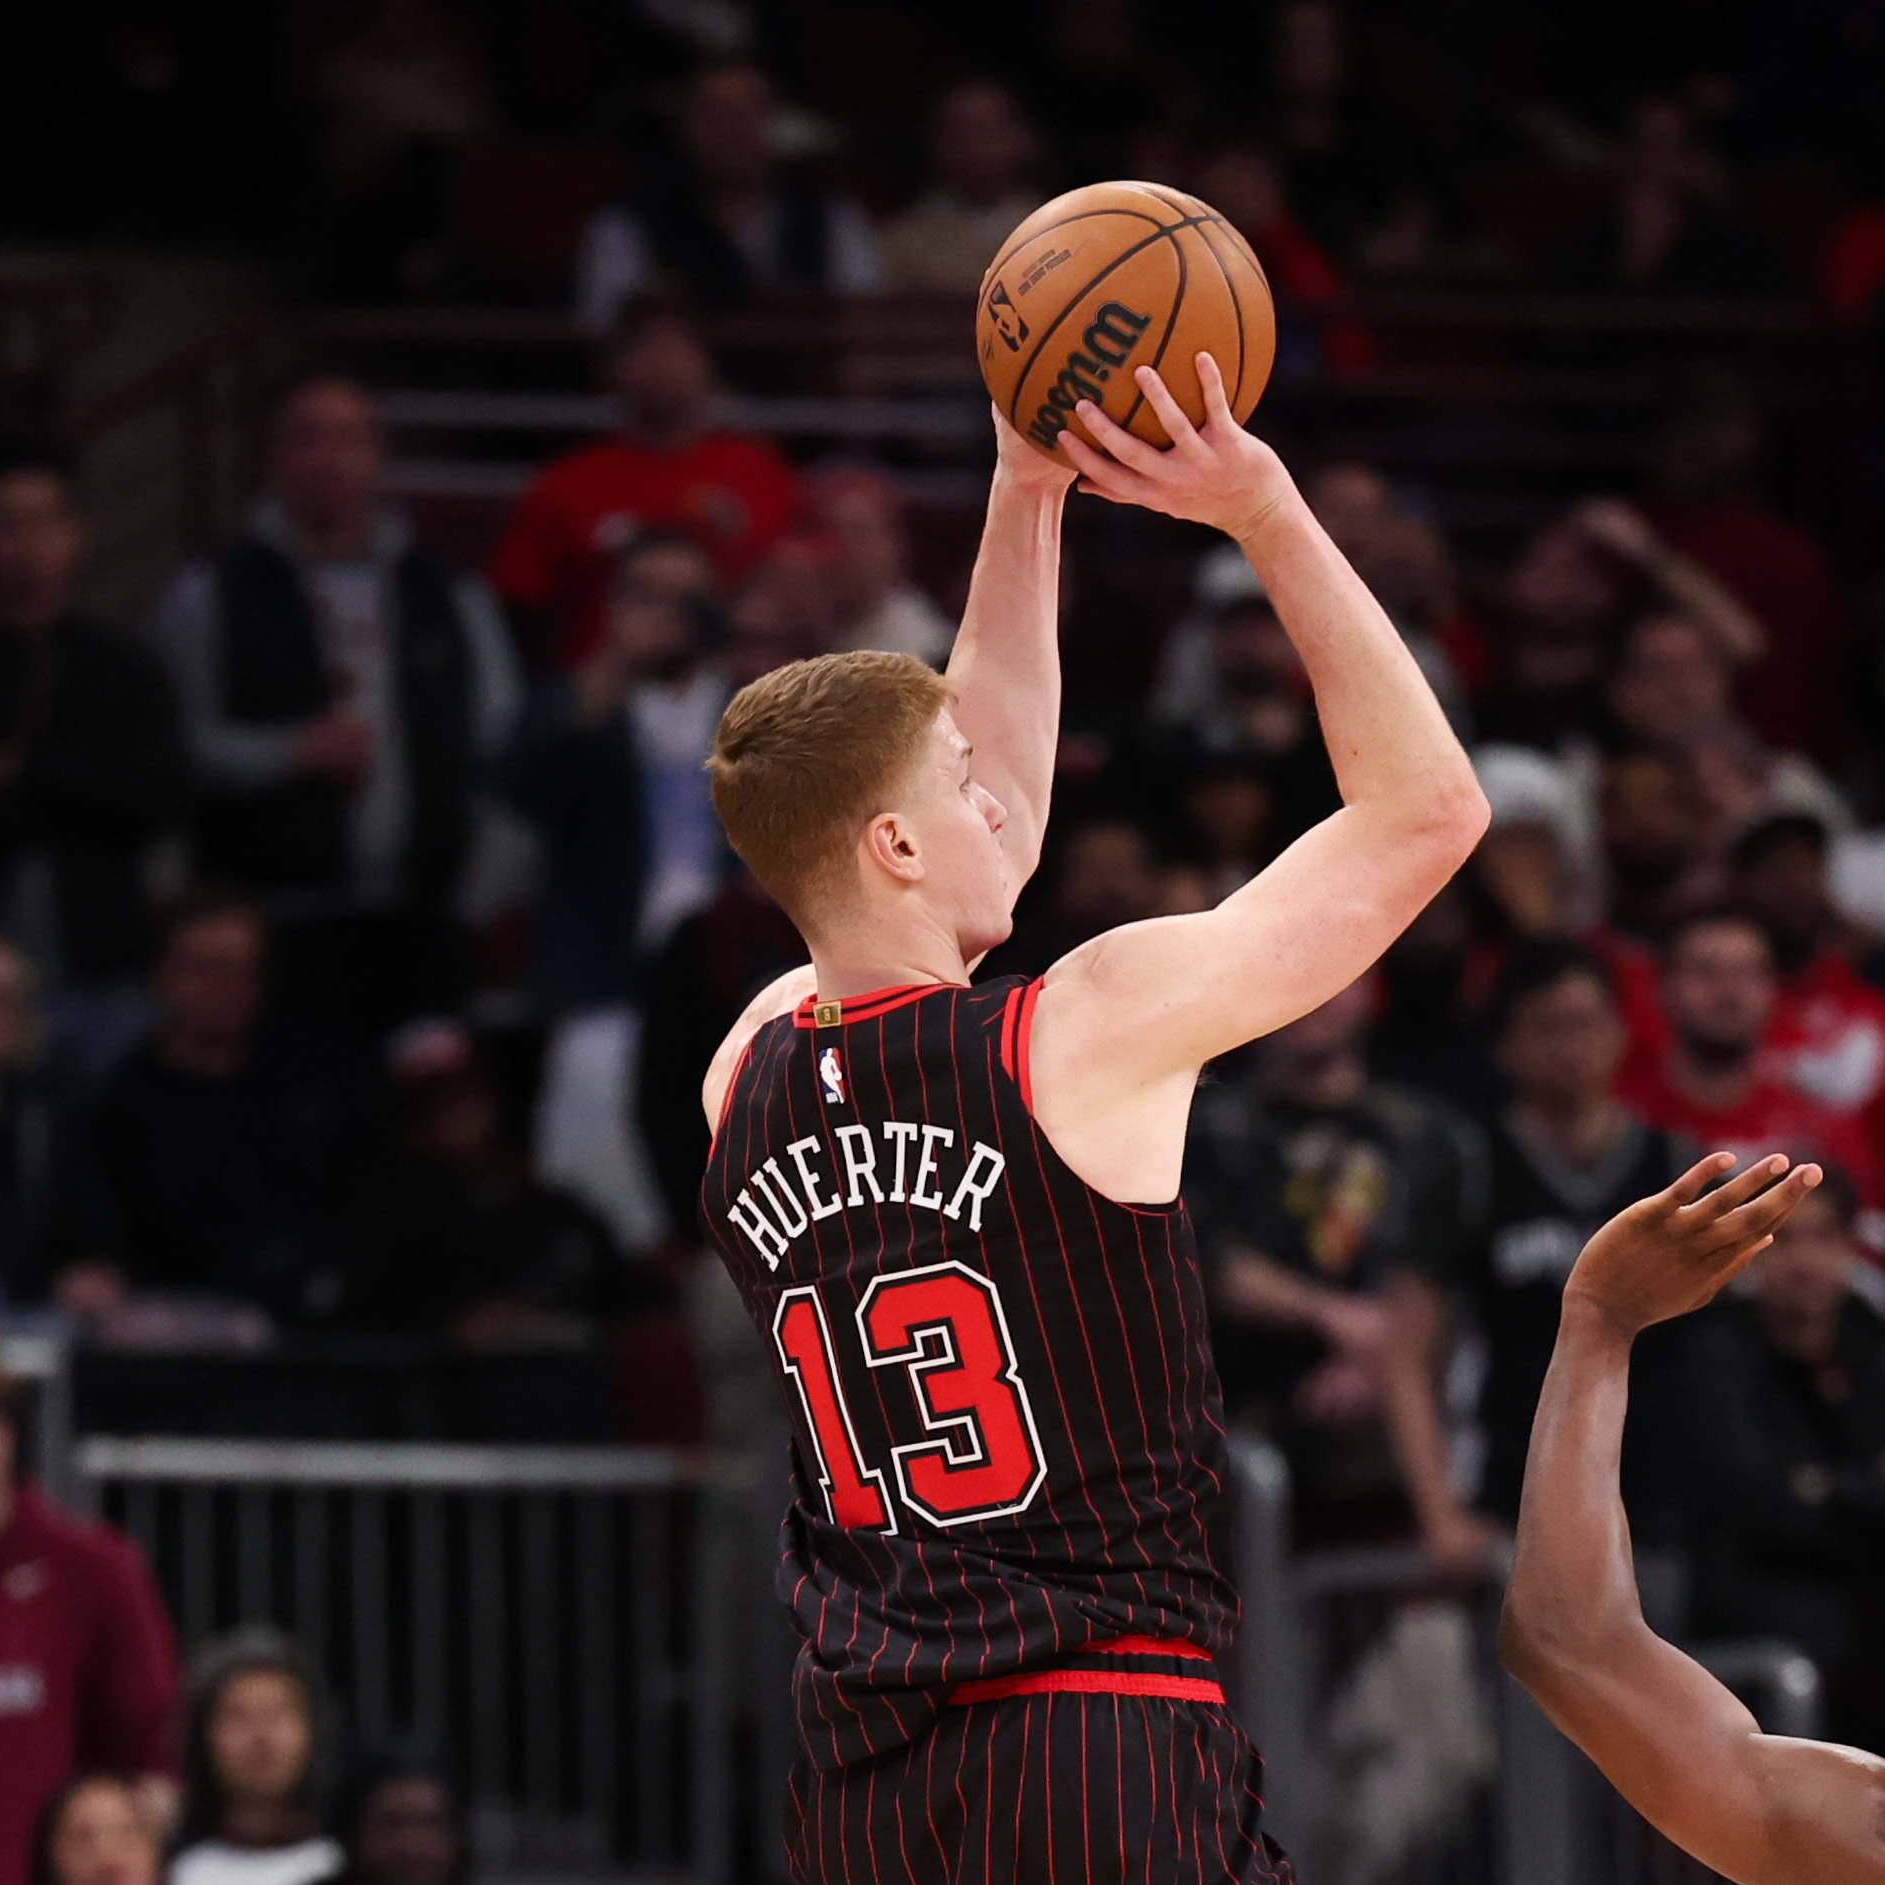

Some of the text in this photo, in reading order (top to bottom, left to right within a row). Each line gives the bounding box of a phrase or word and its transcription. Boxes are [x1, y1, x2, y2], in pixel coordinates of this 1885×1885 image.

[1027, 301, 1153, 450] Wilson
[726, 1120, 1007, 1273] HUERTER
[771, 1259, 1049, 1537] 13
